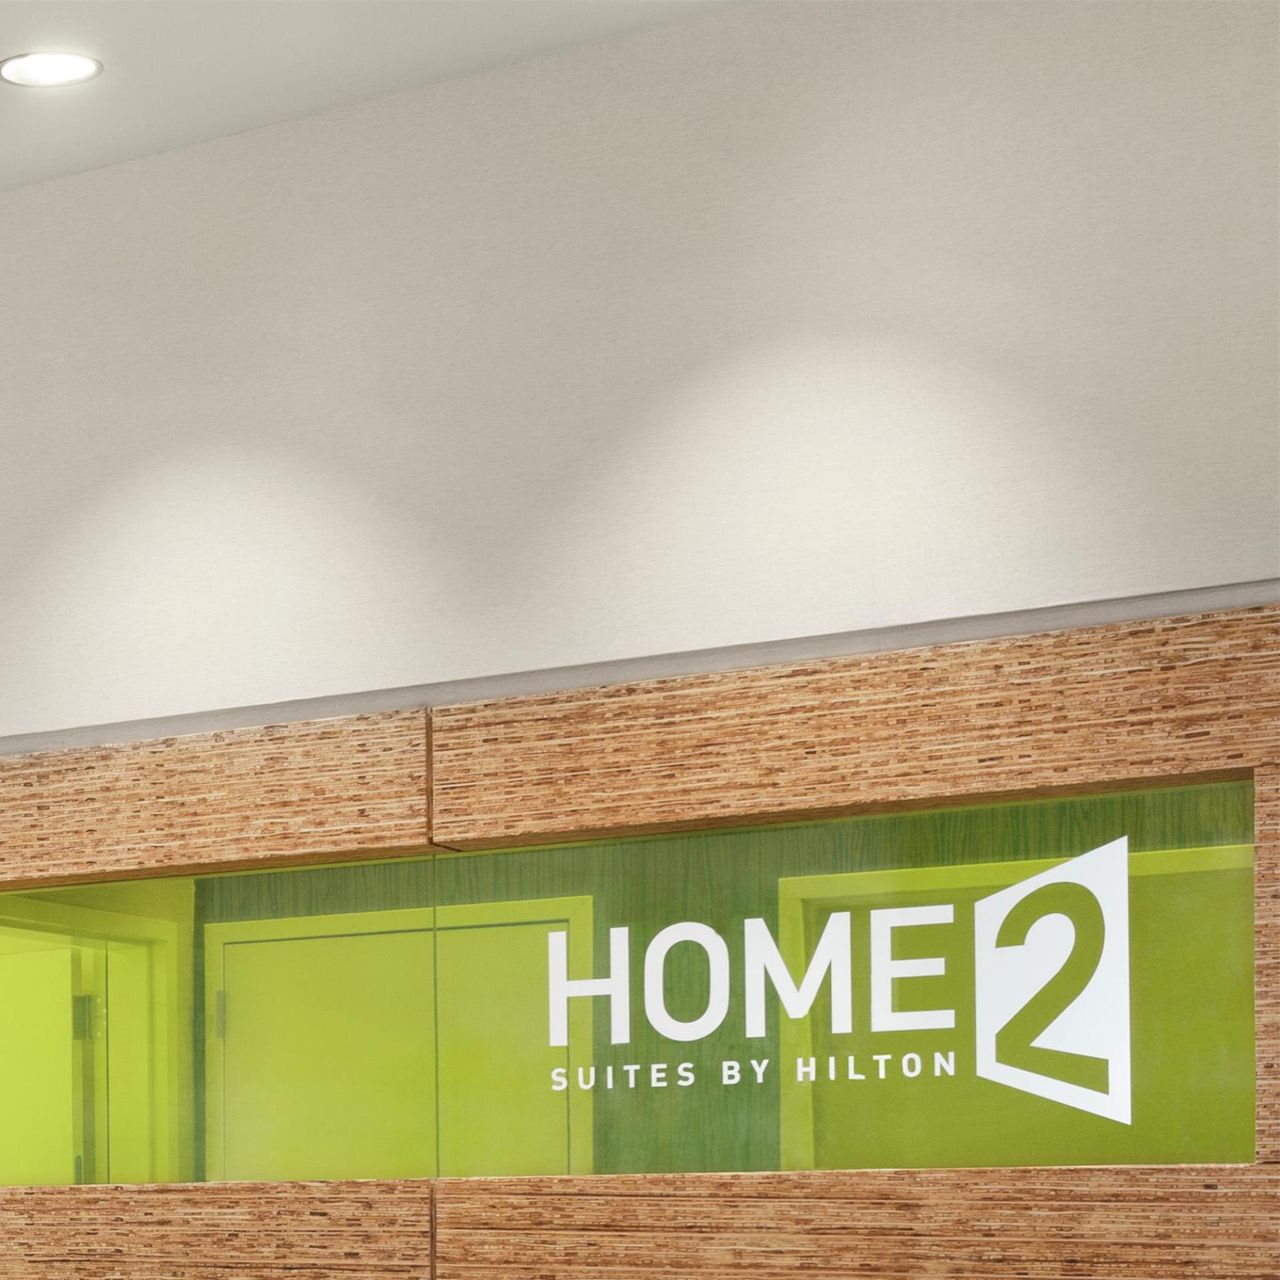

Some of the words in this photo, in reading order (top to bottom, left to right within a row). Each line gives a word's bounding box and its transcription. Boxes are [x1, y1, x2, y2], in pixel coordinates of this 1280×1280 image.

[547, 903, 956, 1047] HOME
[550, 1061, 696, 1091] SUITES
[721, 1058, 767, 1086] BY
[795, 1051, 956, 1082] HILTON
